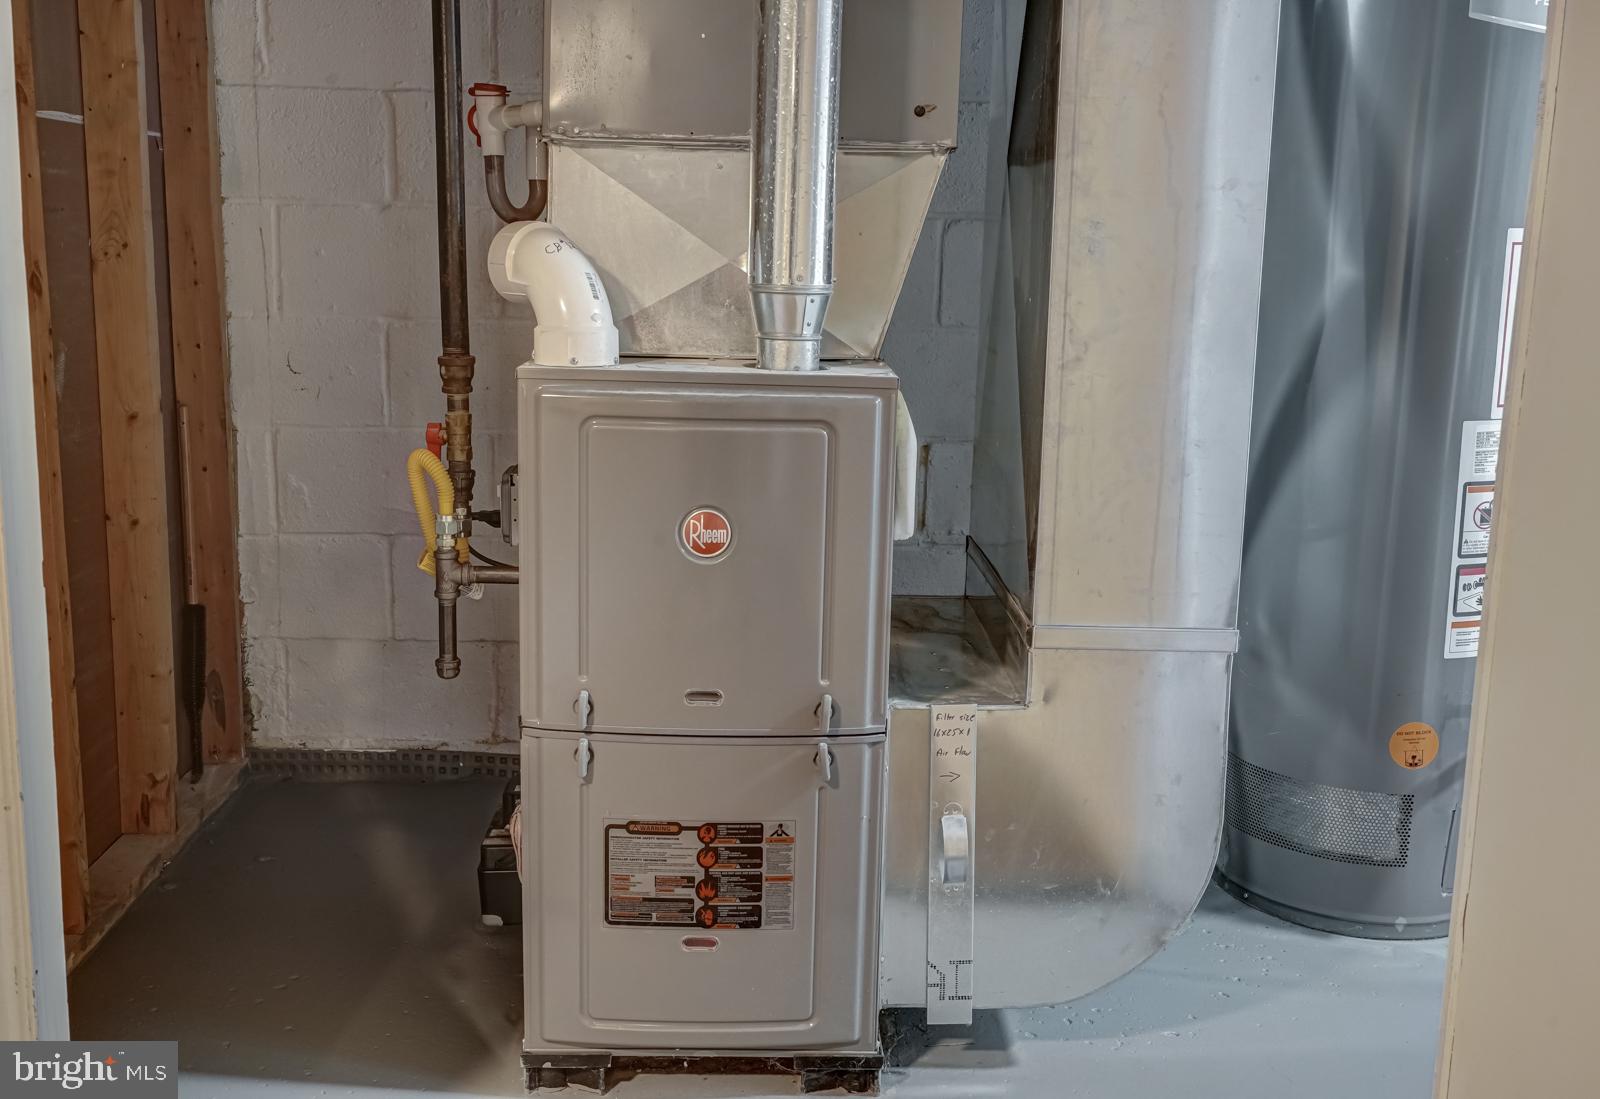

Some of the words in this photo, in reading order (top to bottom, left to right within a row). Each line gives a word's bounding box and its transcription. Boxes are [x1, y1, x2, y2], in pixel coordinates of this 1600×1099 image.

[690, 514, 727, 549] Rheem
[936, 712, 955, 722] Filter
[959, 713, 976, 722] size
[936, 748, 949, 757] Air
